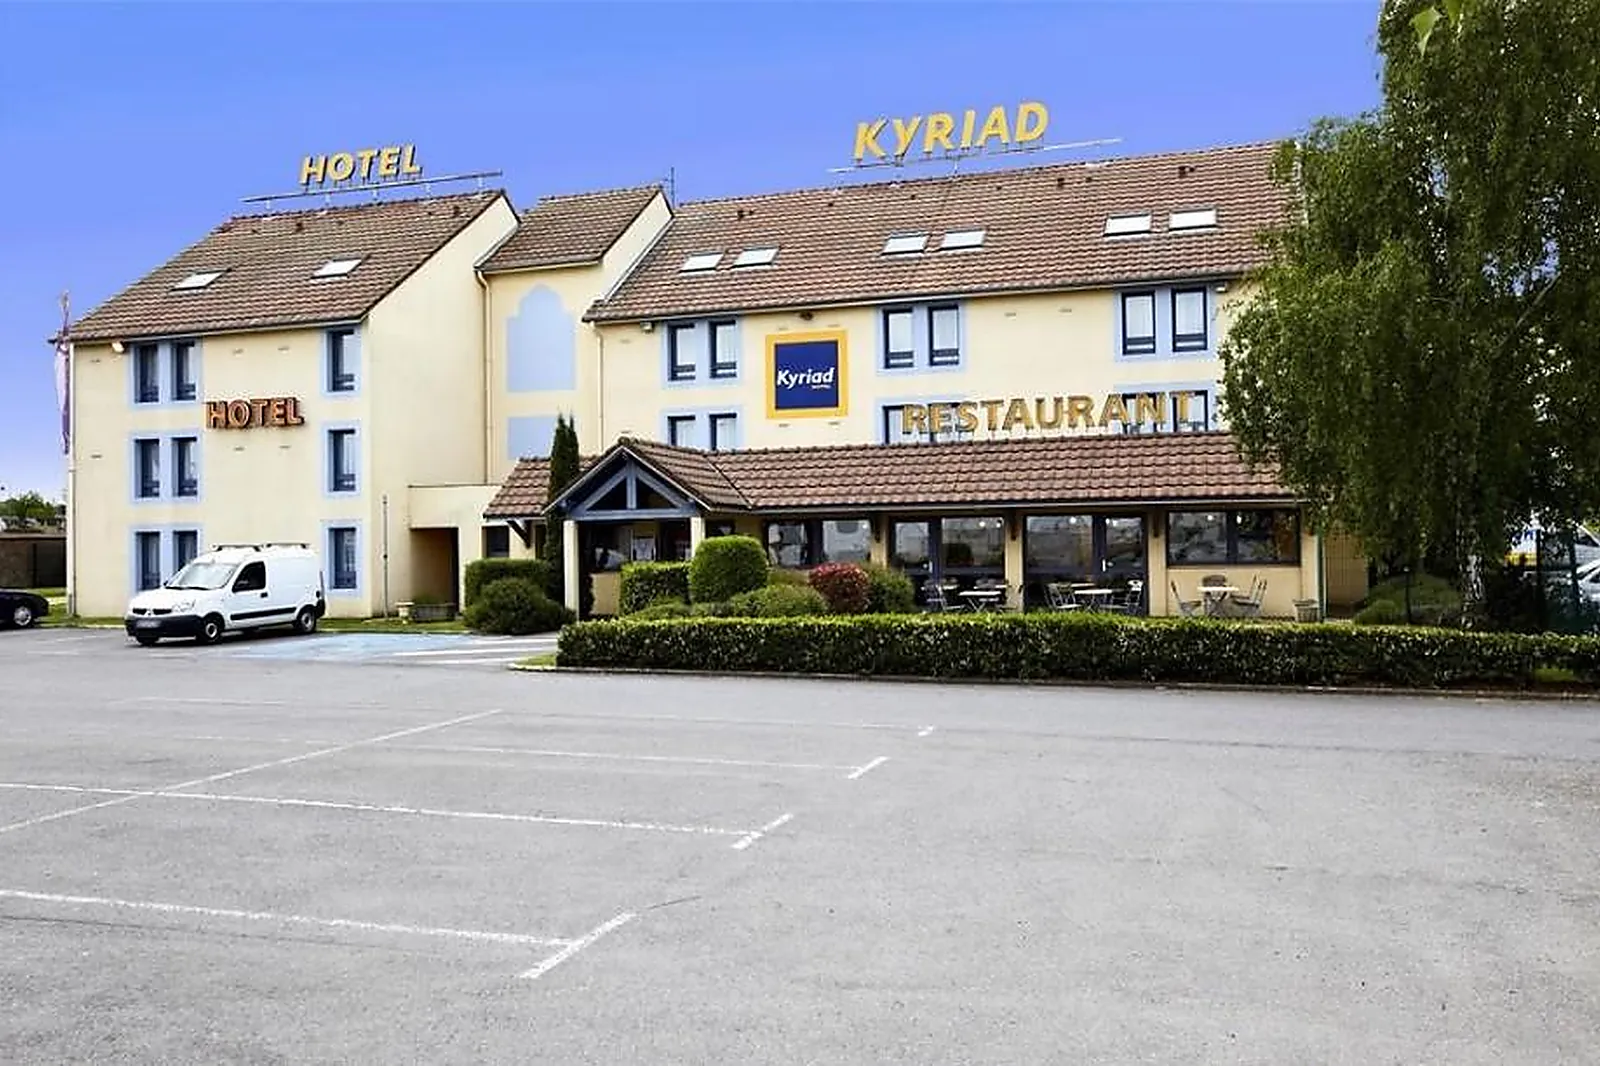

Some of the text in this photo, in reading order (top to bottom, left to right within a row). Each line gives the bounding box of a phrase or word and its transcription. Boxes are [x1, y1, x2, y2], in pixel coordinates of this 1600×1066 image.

[854, 102, 1049, 160] KYRIAD
[300, 144, 422, 185] HOTEL
[777, 367, 835, 390] Kyriad
[204, 397, 305, 429] HOTEL
[902, 391, 1196, 434] RESTAURANT
